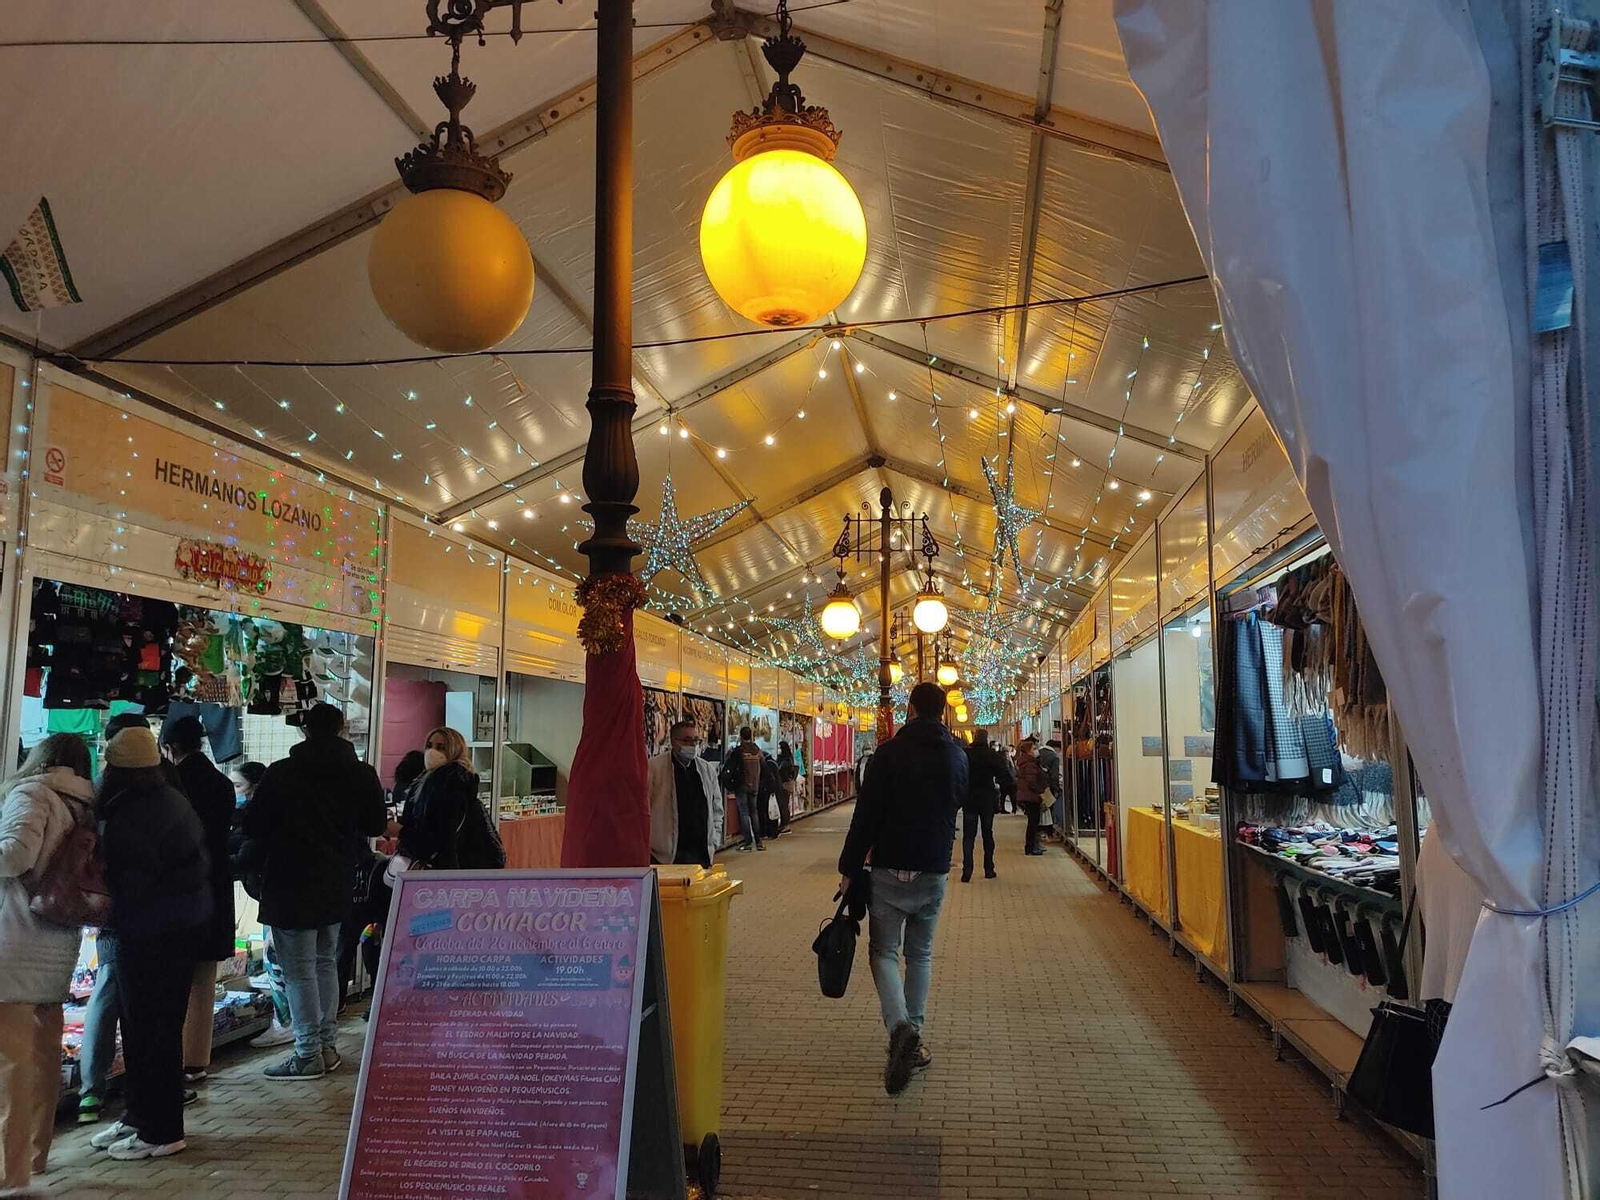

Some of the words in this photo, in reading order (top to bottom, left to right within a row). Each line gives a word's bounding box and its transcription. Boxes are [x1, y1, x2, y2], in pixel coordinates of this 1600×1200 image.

[155, 457, 257, 512] HERMANOS
[261, 496, 321, 532] LOZANO
[412, 888, 499, 909] CARPA
[456, 911, 587, 932] COMACOR
[488, 936, 507, 950] 26
[509, 937, 568, 951] noviembre
[582, 935, 591, 950] 6
[436, 955, 479, 964] HORARIO
[480, 955, 512, 964] CARPA
[540, 955, 604, 965] ACTIVIDADES
[555, 966, 584, 974] 19.00h
[461, 991, 558, 1007] ACTIVIDADES
[449, 1010, 488, 1018] ESPERADA
[430, 1072, 452, 1080] BAILA
[453, 1072, 479, 1080] ZUMBA
[481, 1073, 498, 1081] CON
[521, 1074, 540, 1082] NOEL
[541, 1074, 580, 1083] (OKEYMAS
[603, 1075, 621, 1085] Club)
[430, 1084, 456, 1092] DISNEY
[458, 1084, 498, 1093] NAVIDEÑO
[429, 1105, 458, 1114] SUEÑOS
[404, 1159, 412, 1167] EL
[413, 1159, 448, 1167] REGRESO
[461, 1161, 484, 1169] DRILO
[485, 1162, 494, 1170] EL
[495, 1162, 541, 1171] COCODRILO
[399, 1181, 414, 1189] LOS
